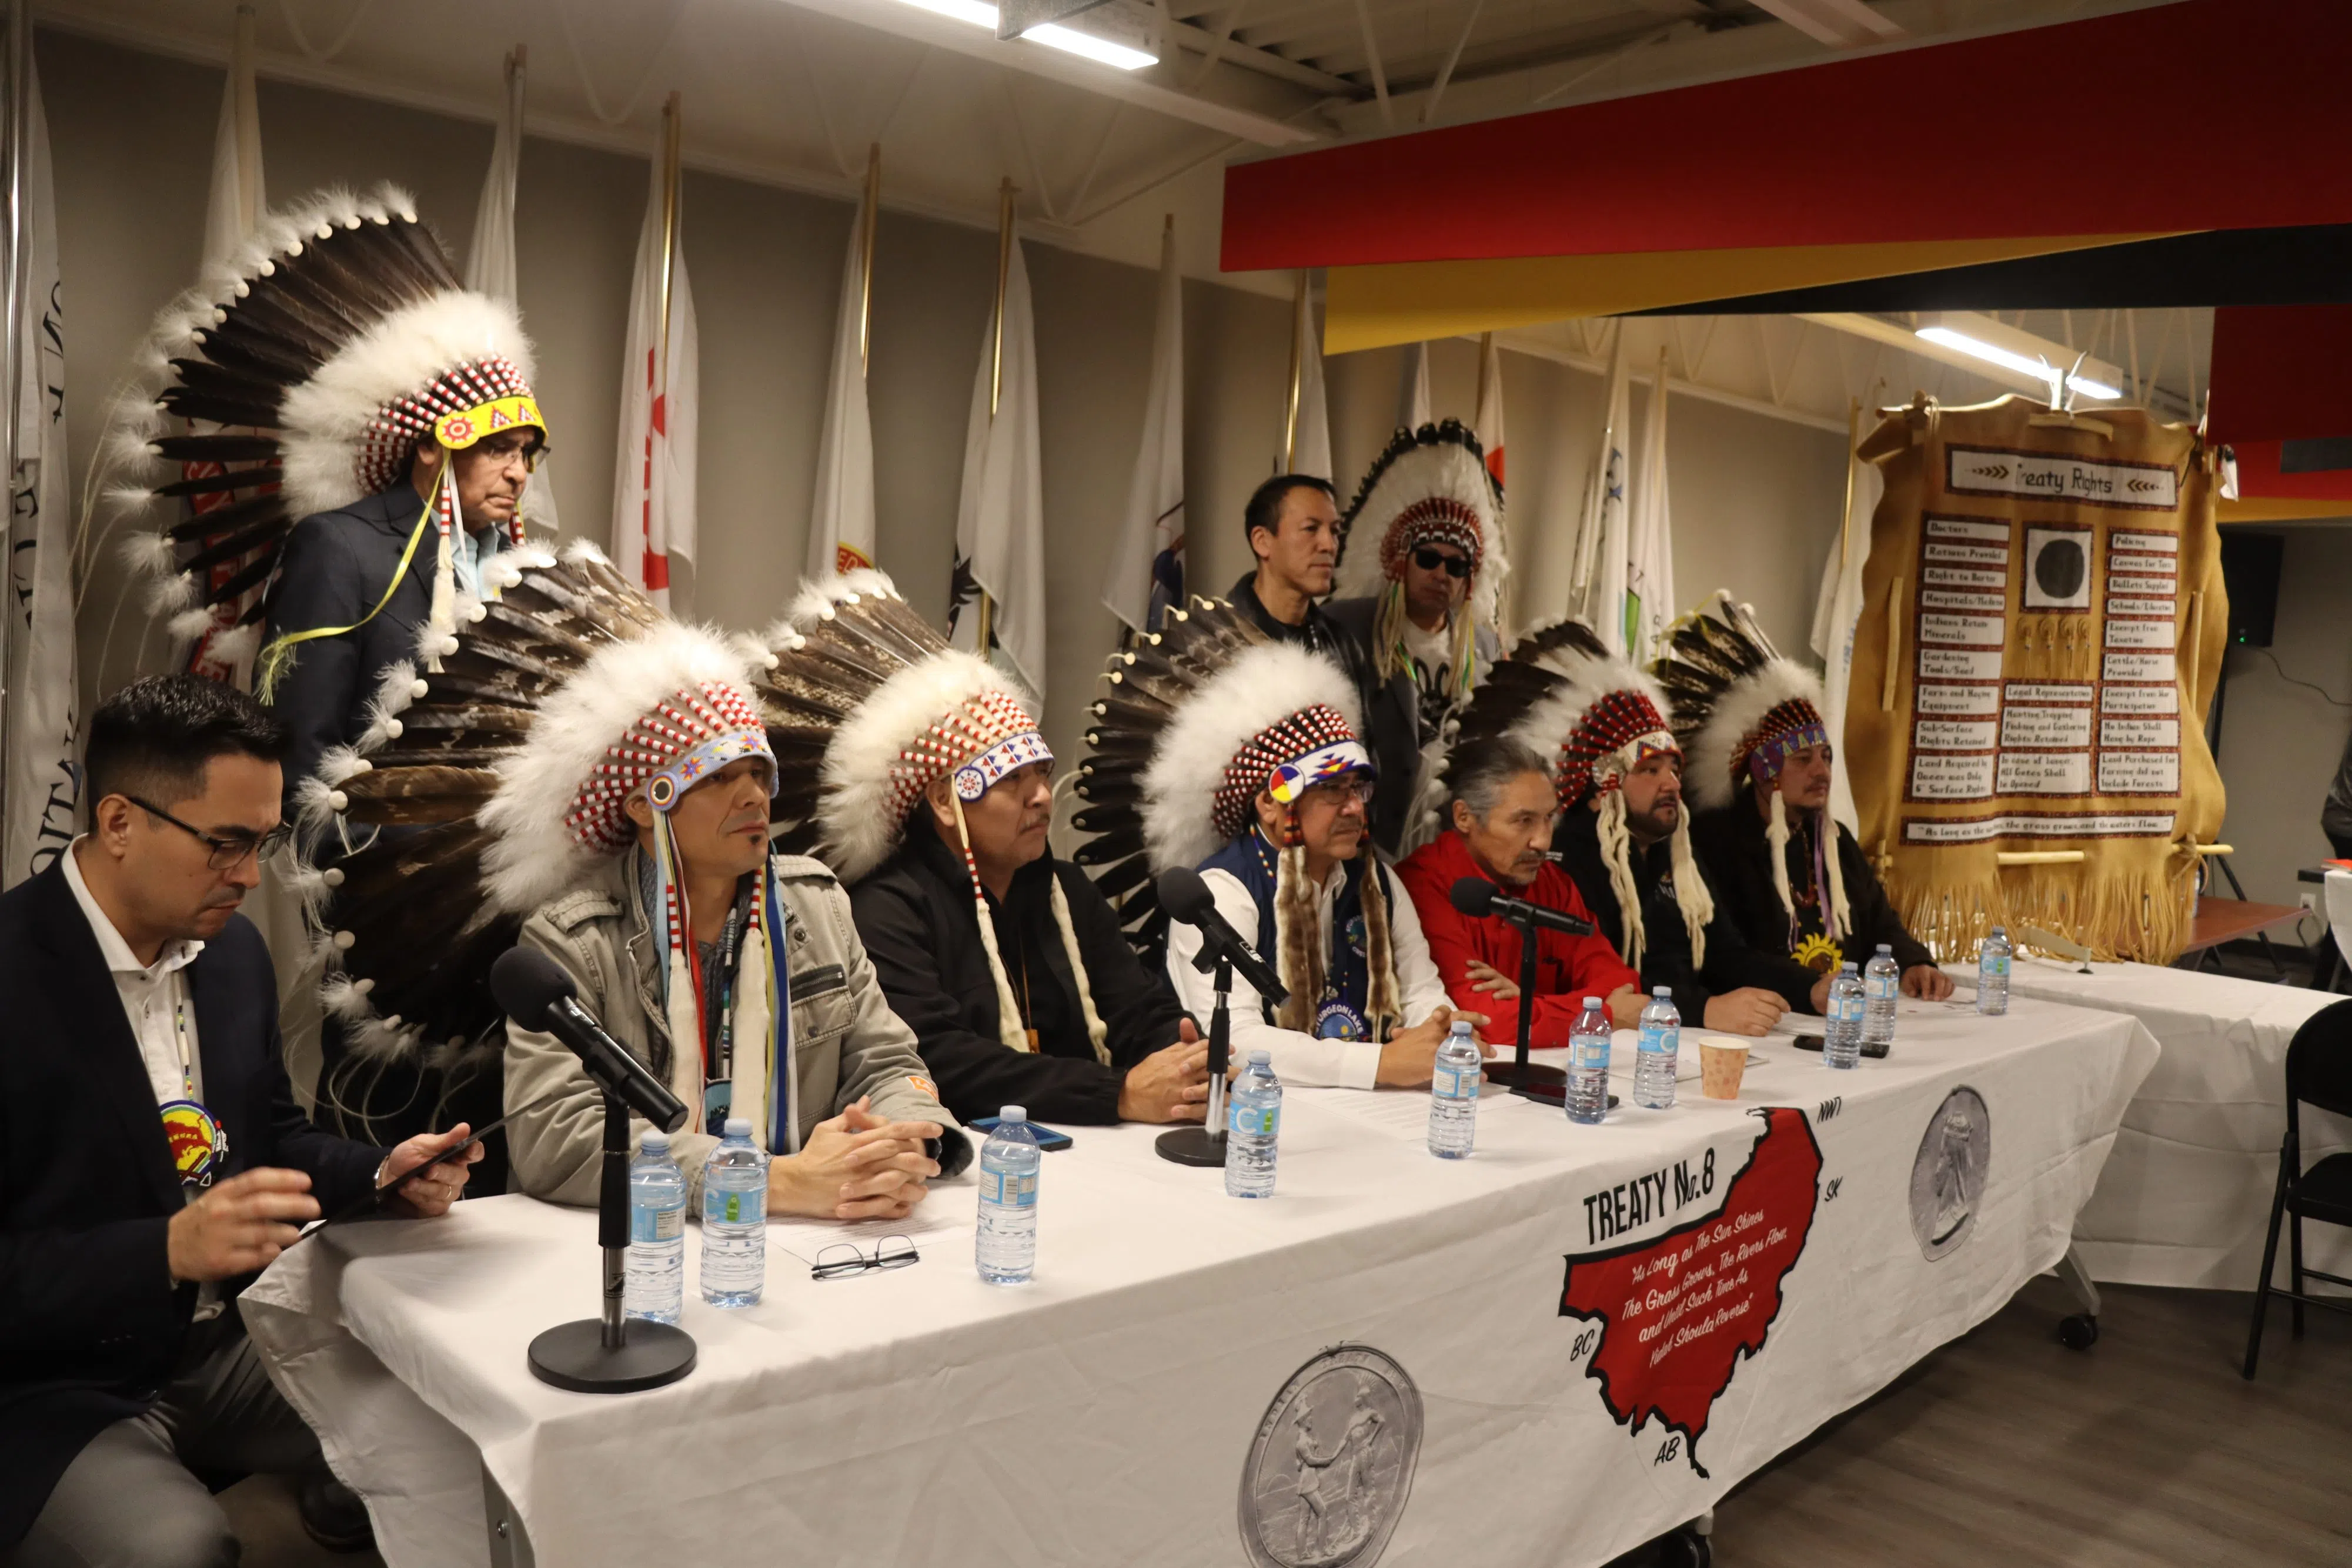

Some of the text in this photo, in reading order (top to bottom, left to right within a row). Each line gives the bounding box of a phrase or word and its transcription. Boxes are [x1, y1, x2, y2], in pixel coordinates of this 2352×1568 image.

[2072, 467, 2113, 497] Rights
[1928, 570, 1954, 580] Right
[1924, 628, 1966, 640] Minerals
[1923, 651, 1970, 664] Gardening
[2107, 668, 2143, 677] Provided
[1950, 689, 1964, 697] and
[2008, 687, 2032, 697] Legal
[1920, 723, 1973, 733] Sub-Surface
[2006, 721, 2035, 733] Fishing
[2118, 722, 2140, 730] Indian
[2143, 722, 2162, 730] Shall
[1920, 735, 1950, 746] Rights
[2004, 734, 2031, 743] Rights
[2104, 734, 2156, 743] Hang by Rope
[1919, 758, 1942, 767] Land
[2102, 755, 2122, 763] Land
[2124, 755, 2163, 764] Purchased
[1916, 771, 1945, 781] Queen
[2014, 767, 2041, 777] Gates
[2044, 768, 2066, 777] Shall
[2102, 767, 2134, 777] Farming
[2137, 767, 2149, 775] did
[2010, 780, 2041, 789] Opened
[2101, 778, 2163, 787] Include Forests
[1929, 784, 1963, 794] Surface
[1974, 825, 1984, 835] the
[2006, 821, 2020, 829] the
[2023, 823, 2050, 831] grass
[1347, 1009, 1364, 1034] LAKE
[1816, 1096, 1842, 1125] NWT
[1824, 1177, 1843, 1203] SK
[1583, 1167, 1669, 1245] TREATY
[1647, 1253, 1678, 1278] Long
[1681, 1245, 1693, 1263] as
[1695, 1231, 1710, 1253] The
[1712, 1223, 1733, 1243] Sun
[1733, 1209, 1763, 1233] Shines
[1622, 1297, 1643, 1321] The
[1645, 1283, 1681, 1310] Grass
[1719, 1250, 1735, 1271] The
[1736, 1238, 1765, 1263] Rivers
[1639, 1268, 1749, 1342] and Until Such Time As
[1674, 1315, 1715, 1347] Should
[1570, 1329, 1595, 1362] BC
[1654, 1436, 1680, 1467] AB
